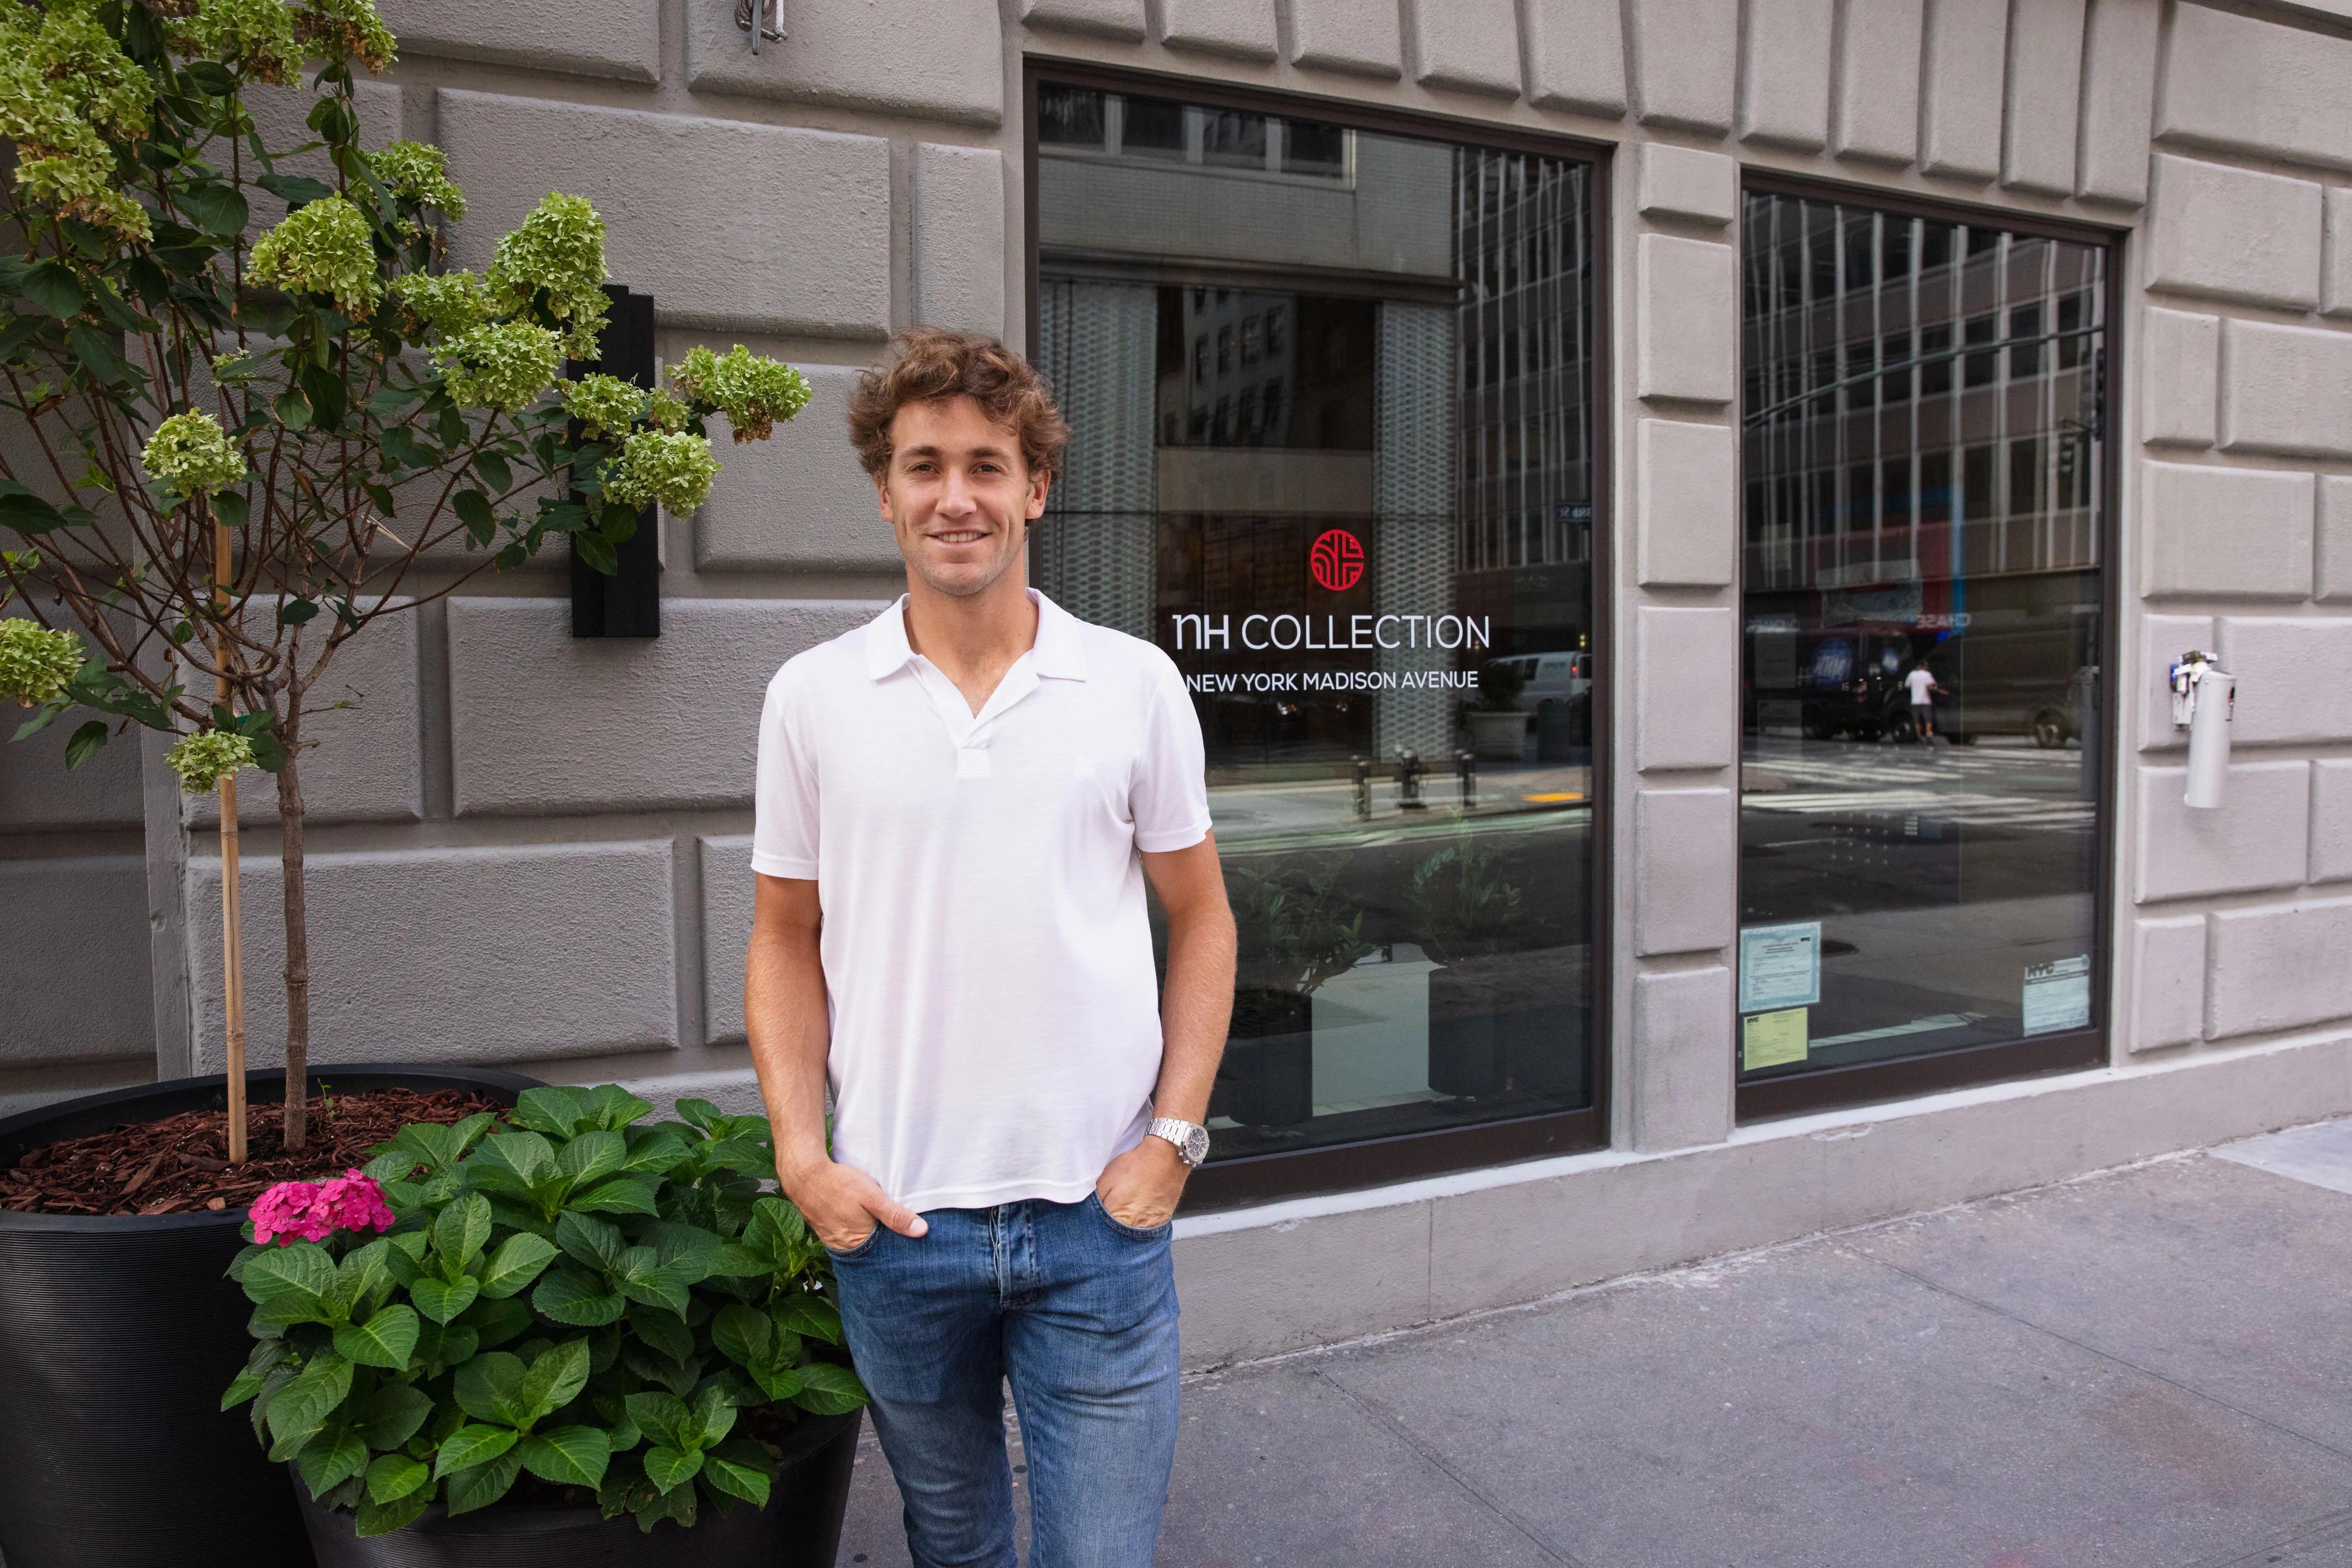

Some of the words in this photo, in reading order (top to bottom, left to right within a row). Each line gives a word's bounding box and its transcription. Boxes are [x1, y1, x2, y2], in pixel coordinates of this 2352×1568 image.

[1242, 614, 1490, 649] COLLECTION
[1186, 674, 1237, 693] NEW
[1241, 673, 1298, 691] YORK
[1303, 672, 1396, 690] MADISON
[1401, 671, 1478, 689] AVENUE
[2028, 962, 2054, 978] NYC
